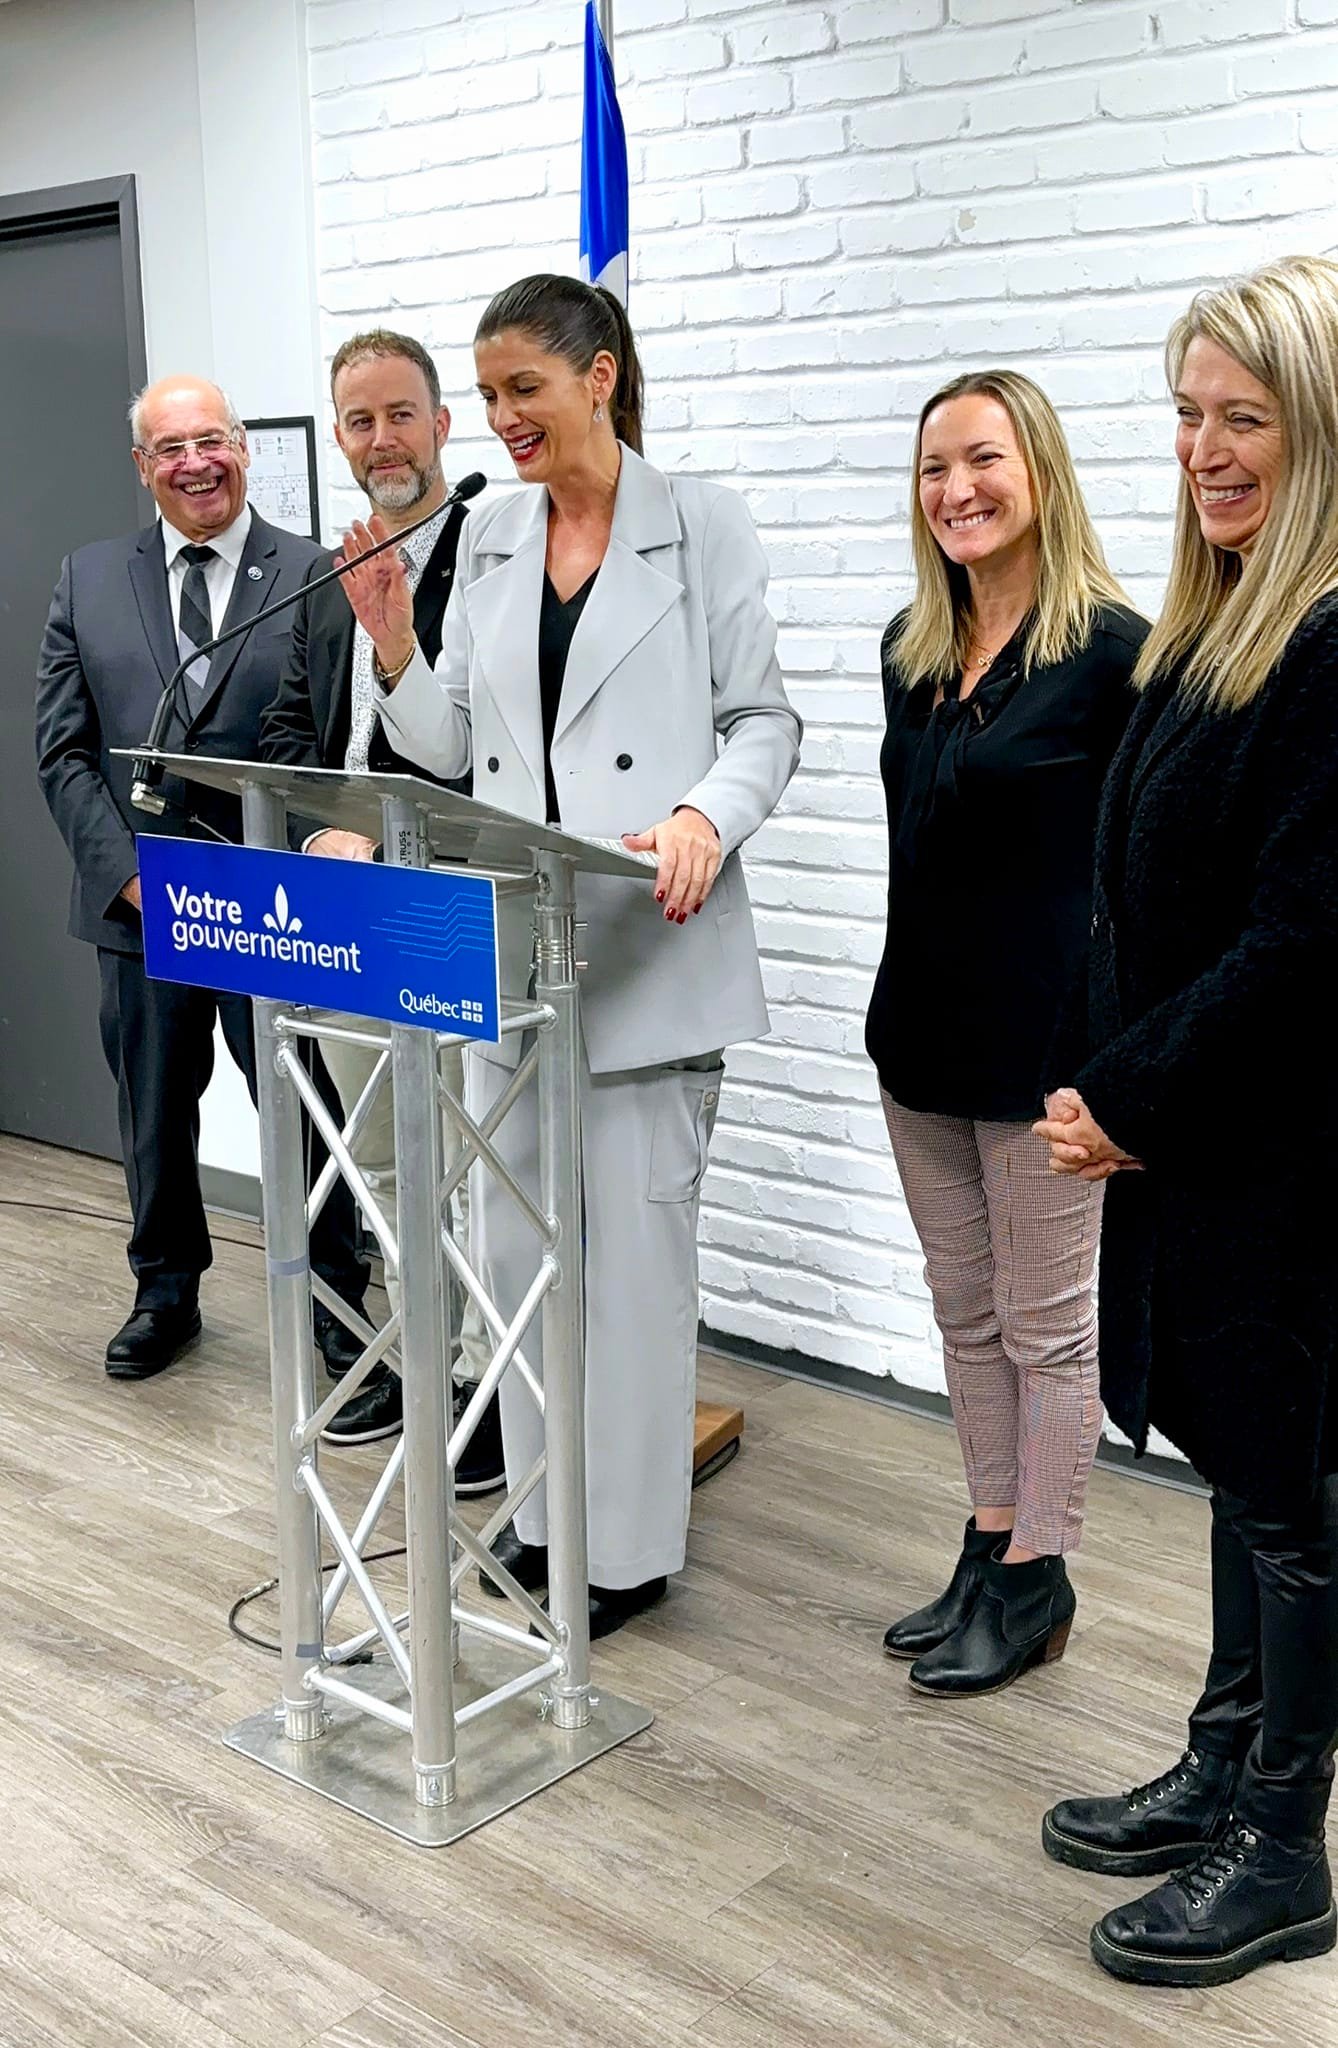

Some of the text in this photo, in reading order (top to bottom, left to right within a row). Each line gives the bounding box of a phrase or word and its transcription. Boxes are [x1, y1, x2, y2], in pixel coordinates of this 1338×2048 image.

[398, 830, 407, 862] TRUSS
[166, 883, 242, 924] Votre
[171, 922, 362, 973] gouvernement
[399, 988, 460, 1020] Québec
